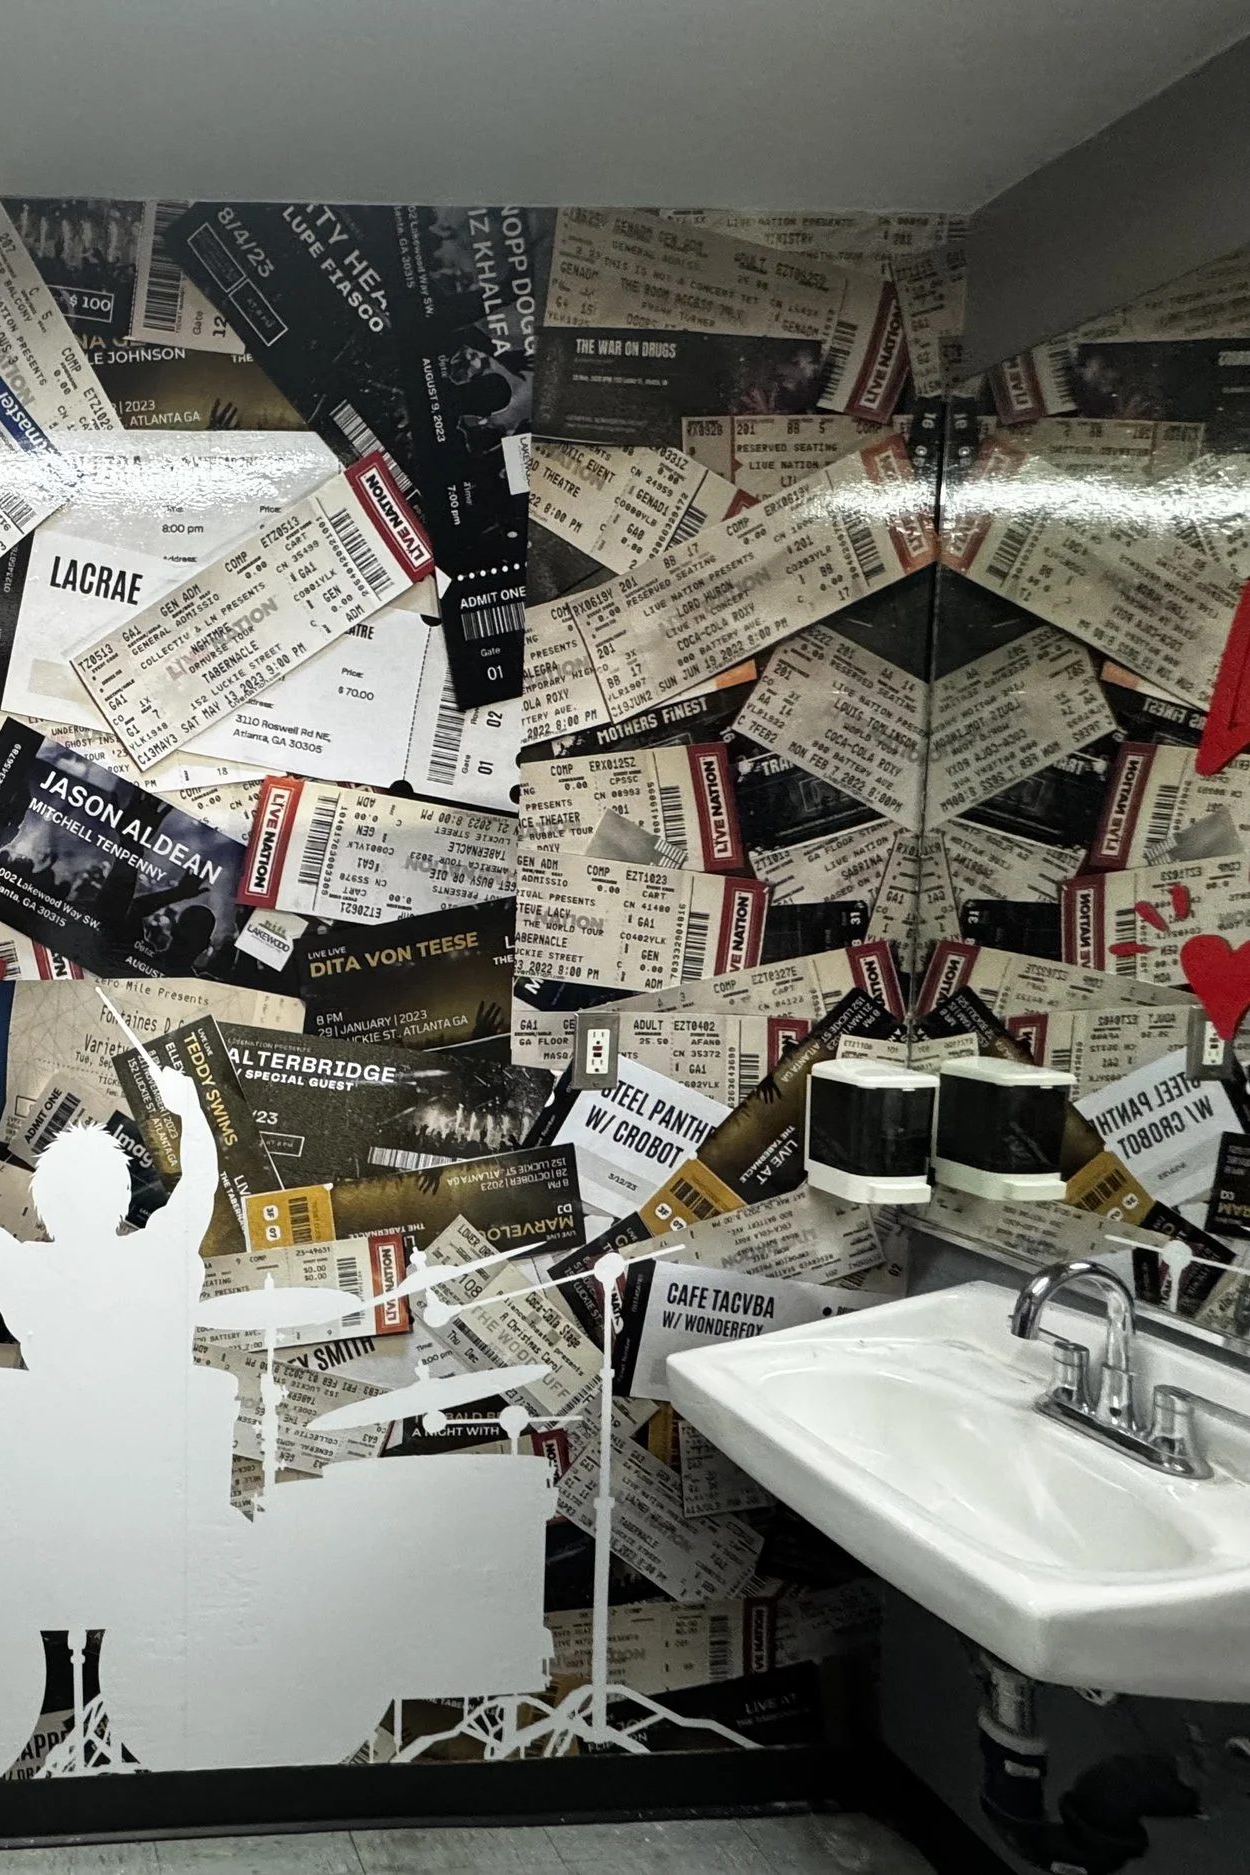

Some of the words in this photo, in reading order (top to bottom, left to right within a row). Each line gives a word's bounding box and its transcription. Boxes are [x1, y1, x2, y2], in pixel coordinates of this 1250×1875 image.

[217, 207, 276, 278] 8/4/23
[282, 206, 325, 258] LUPE
[320, 258, 384, 333] FIASCO
[472, 241, 512, 357] KHALIFA
[108, 348, 186, 365] JOHNSON
[576, 339, 594, 354] THE
[598, 340, 621, 356] WAR
[624, 341, 639, 357] ON
[642, 342, 677, 358] DRUGS
[162, 524, 184, 533] 8:00
[188, 525, 204, 534] pm
[364, 475, 406, 531] NATION
[395, 526, 431, 567] LIVE
[50, 556, 143, 605] LACRAE
[460, 590, 504, 610] ADMIT
[506, 586, 527, 600] ONE
[481, 646, 501, 657] Gate
[487, 666, 504, 681] 01
[236, 714, 258, 727] 3110
[261, 720, 298, 736] Roswell
[300, 728, 314, 737] Rd
[486, 710, 503, 729] 02
[597, 713, 658, 744] MOTHERS
[233, 729, 270, 744] Atlanta,
[272, 736, 287, 745] GA
[289, 738, 322, 754] 30305
[551, 763, 574, 776] COMP
[700, 761, 727, 812] NATION
[266, 792, 285, 828] LIVE
[28, 798, 102, 848] MITCHELL
[96, 834, 166, 882] TENPENNY
[39, 770, 122, 829] JASON
[119, 819, 222, 885] ALDEAN
[712, 811, 730, 857] LIVE
[248, 828, 281, 889] NATION
[18, 877, 62, 909] Lakewood
[61, 900, 83, 922] Way
[21, 896, 38, 910] GA
[37, 905, 66, 928] 30315
[246, 922, 291, 954] LAKEWOOD
[310, 953, 361, 978] DITA
[364, 944, 412, 966] VON
[416, 931, 479, 957] TEESE
[125, 981, 151, 995] Mile
[158, 987, 209, 1006] Presents
[403, 1018, 450, 1036] ATLANTA
[451, 1014, 468, 1027] GA
[633, 1019, 663, 1031] ADULT
[228, 1049, 397, 1083] ALTERBRIDGE
[244, 1069, 305, 1086] SPECIAL
[309, 1075, 354, 1091] GUEST
[184, 1032, 216, 1087] TEDDY
[206, 1089, 239, 1146] SWIMS
[24, 1111, 48, 1143] ADMIT
[44, 1087, 62, 1111] ONE
[650, 1100, 717, 1145] PANTH
[585, 1105, 614, 1131] W/
[613, 1122, 684, 1169] CROBOT
[772, 1139, 799, 1167] LIVE
[759, 1167, 780, 1186] AT
[557, 1203, 572, 1214] DJ
[459, 1274, 483, 1298] 108
[667, 1282, 708, 1309] CAFE
[712, 1291, 774, 1319] TACVBA
[662, 1311, 682, 1328] W/
[316, 1338, 377, 1371] SMITH
